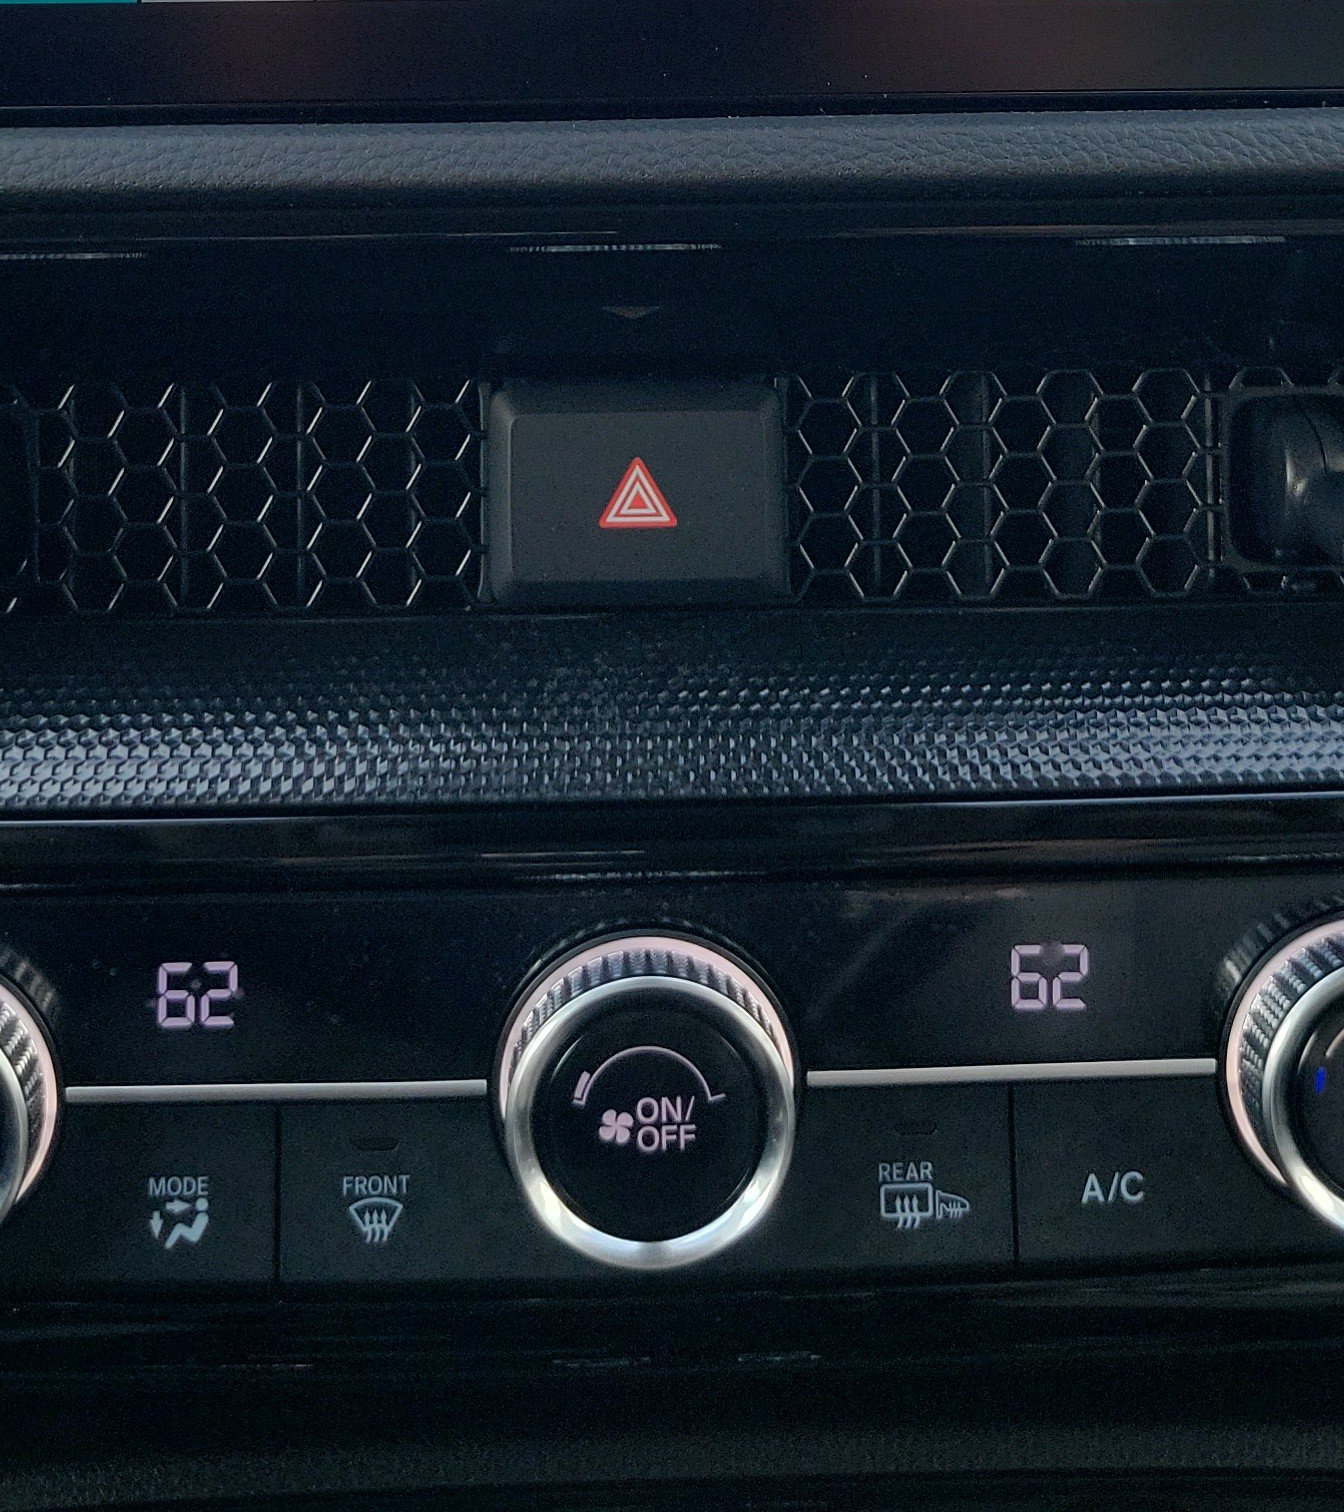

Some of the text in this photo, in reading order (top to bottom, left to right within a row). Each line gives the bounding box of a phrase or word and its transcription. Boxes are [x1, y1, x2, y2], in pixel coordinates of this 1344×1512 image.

[1010, 944, 1089, 1011] 62
[157, 961, 239, 1029] 62
[636, 1096, 695, 1124] ON/
[636, 1125, 696, 1152] OFF
[342, 1175, 409, 1196] FRONT
[879, 1162, 933, 1182] REAR
[148, 1176, 208, 1197] MODE
[1081, 1171, 1146, 1205] A/C
